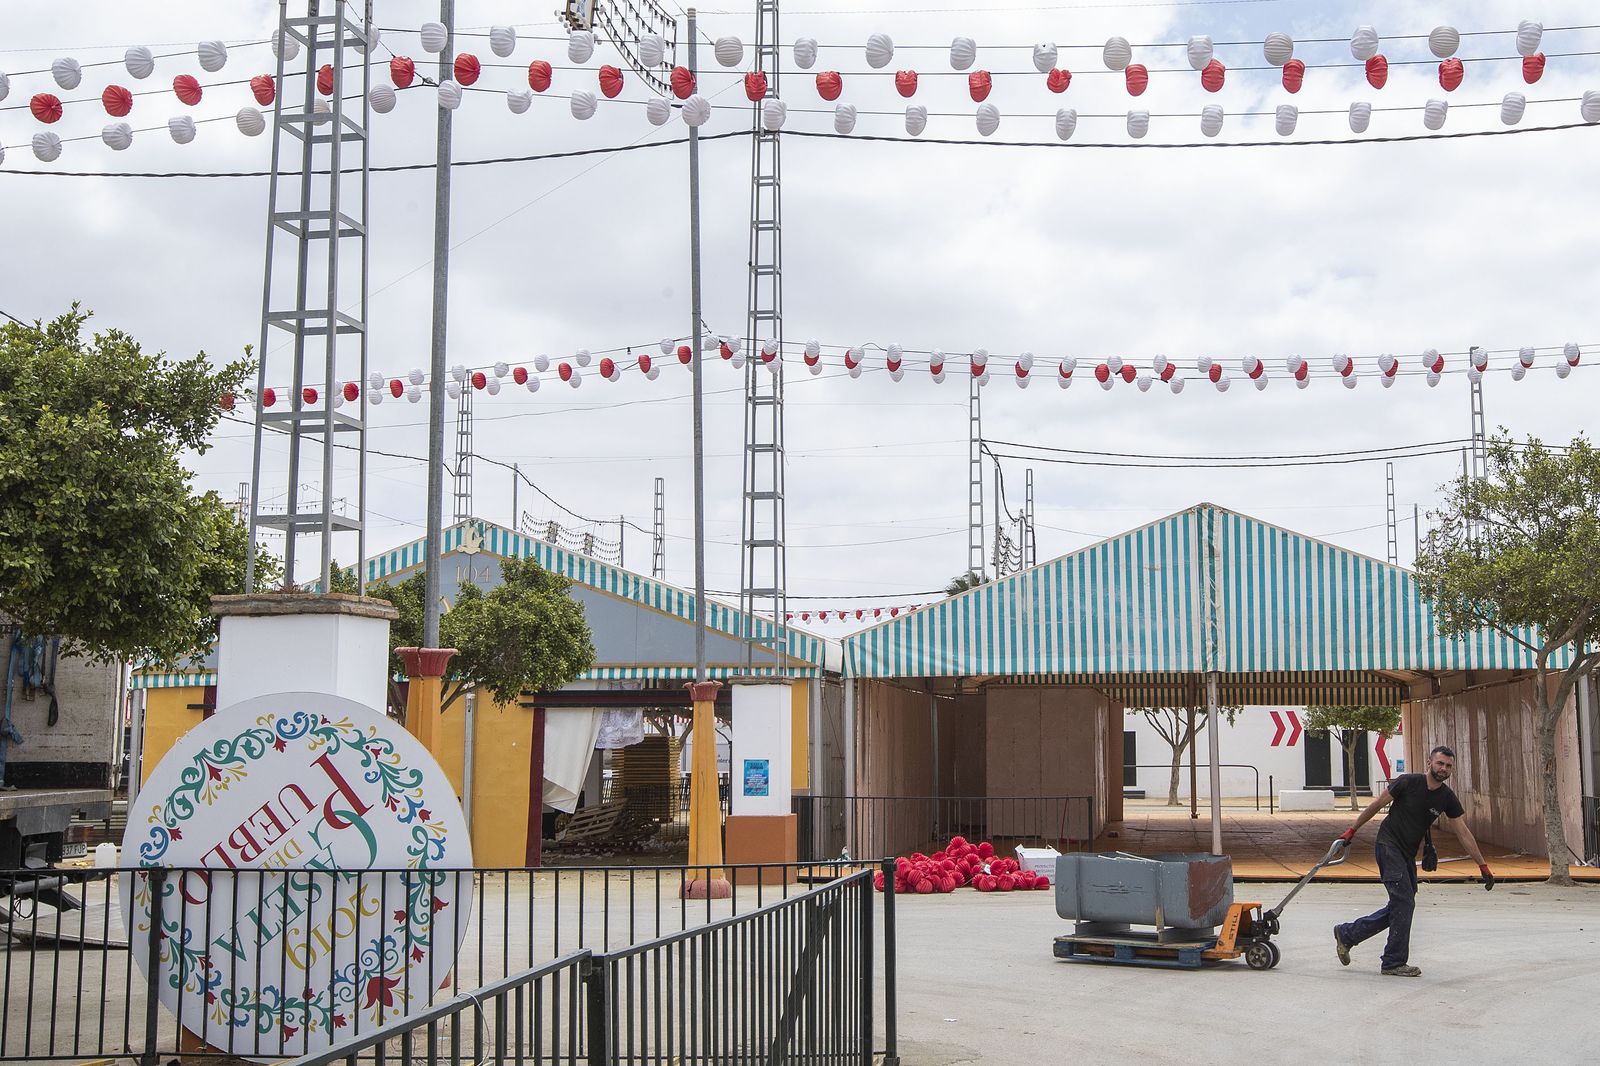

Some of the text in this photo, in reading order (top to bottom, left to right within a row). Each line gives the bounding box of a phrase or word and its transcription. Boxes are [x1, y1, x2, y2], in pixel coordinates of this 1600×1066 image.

[456, 566, 492, 583] 104
[178, 751, 374, 905] PUEBLO
[256, 837, 304, 879] DEL
[211, 809, 378, 962] CASETA
[285, 883, 379, 970] 2019
[1229, 912, 1239, 940] STILL
